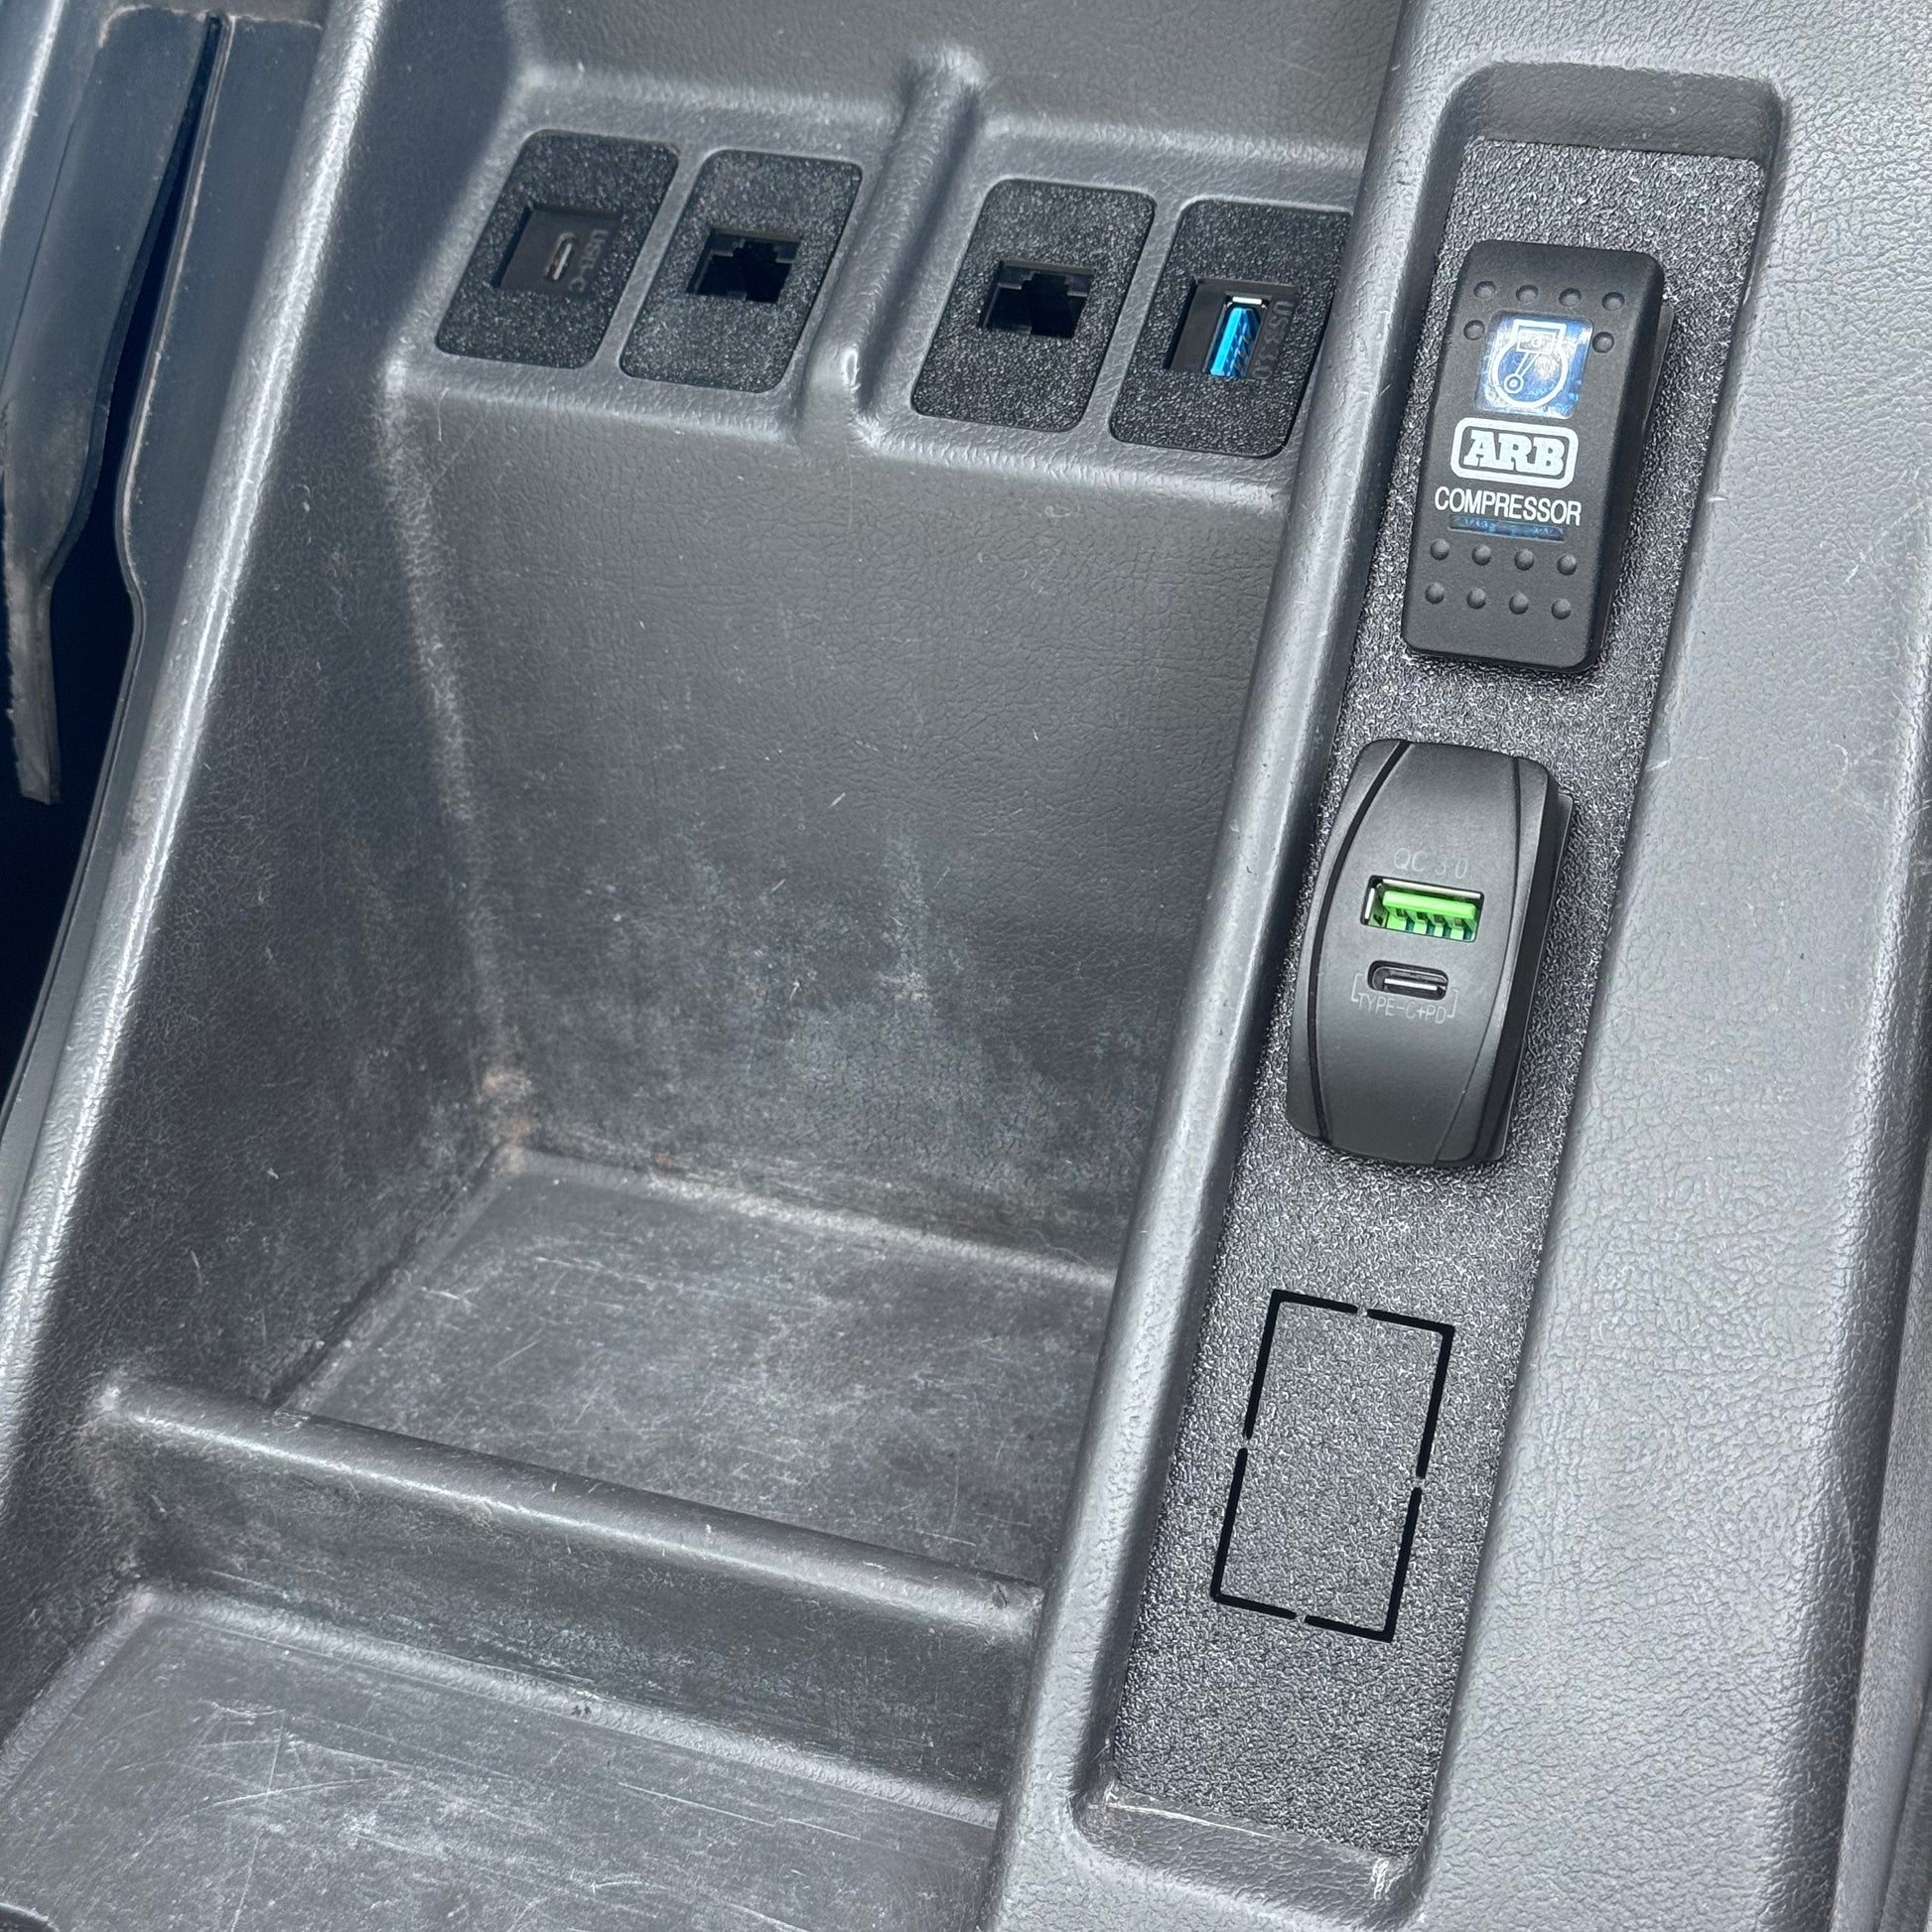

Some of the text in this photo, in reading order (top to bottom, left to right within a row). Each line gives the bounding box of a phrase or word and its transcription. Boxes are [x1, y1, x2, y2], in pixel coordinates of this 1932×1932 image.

[1464, 431, 1566, 477] ARB
[1435, 485, 1583, 526] COMPRESSOR
[1393, 848, 1428, 871] QC
[1357, 994, 1447, 1025] TYPE-C+PD
